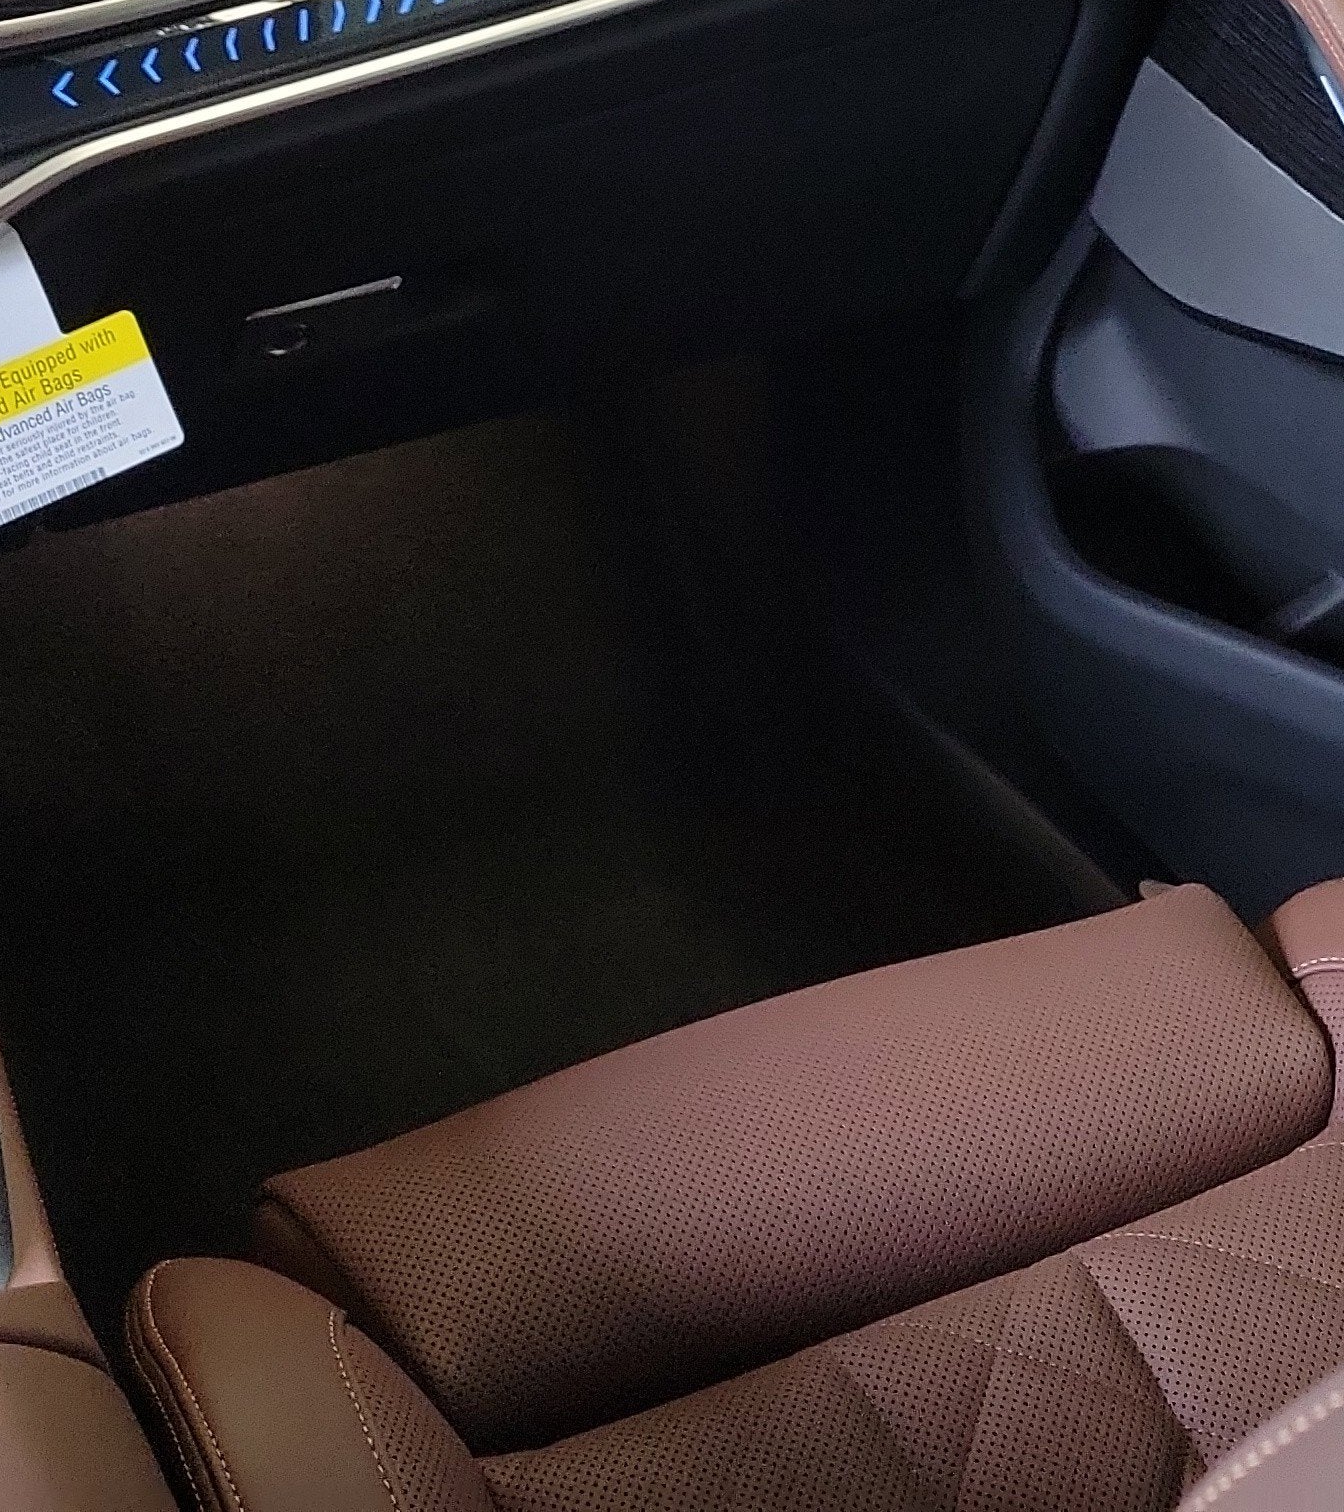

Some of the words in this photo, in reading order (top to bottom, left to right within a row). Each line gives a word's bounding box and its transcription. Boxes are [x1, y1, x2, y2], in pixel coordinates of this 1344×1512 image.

[79, 329, 117, 354] with
[14, 387, 36, 409] Air
[39, 369, 83, 396] Bags
[55, 399, 74, 418] Air
[76, 384, 112, 407] Bags
